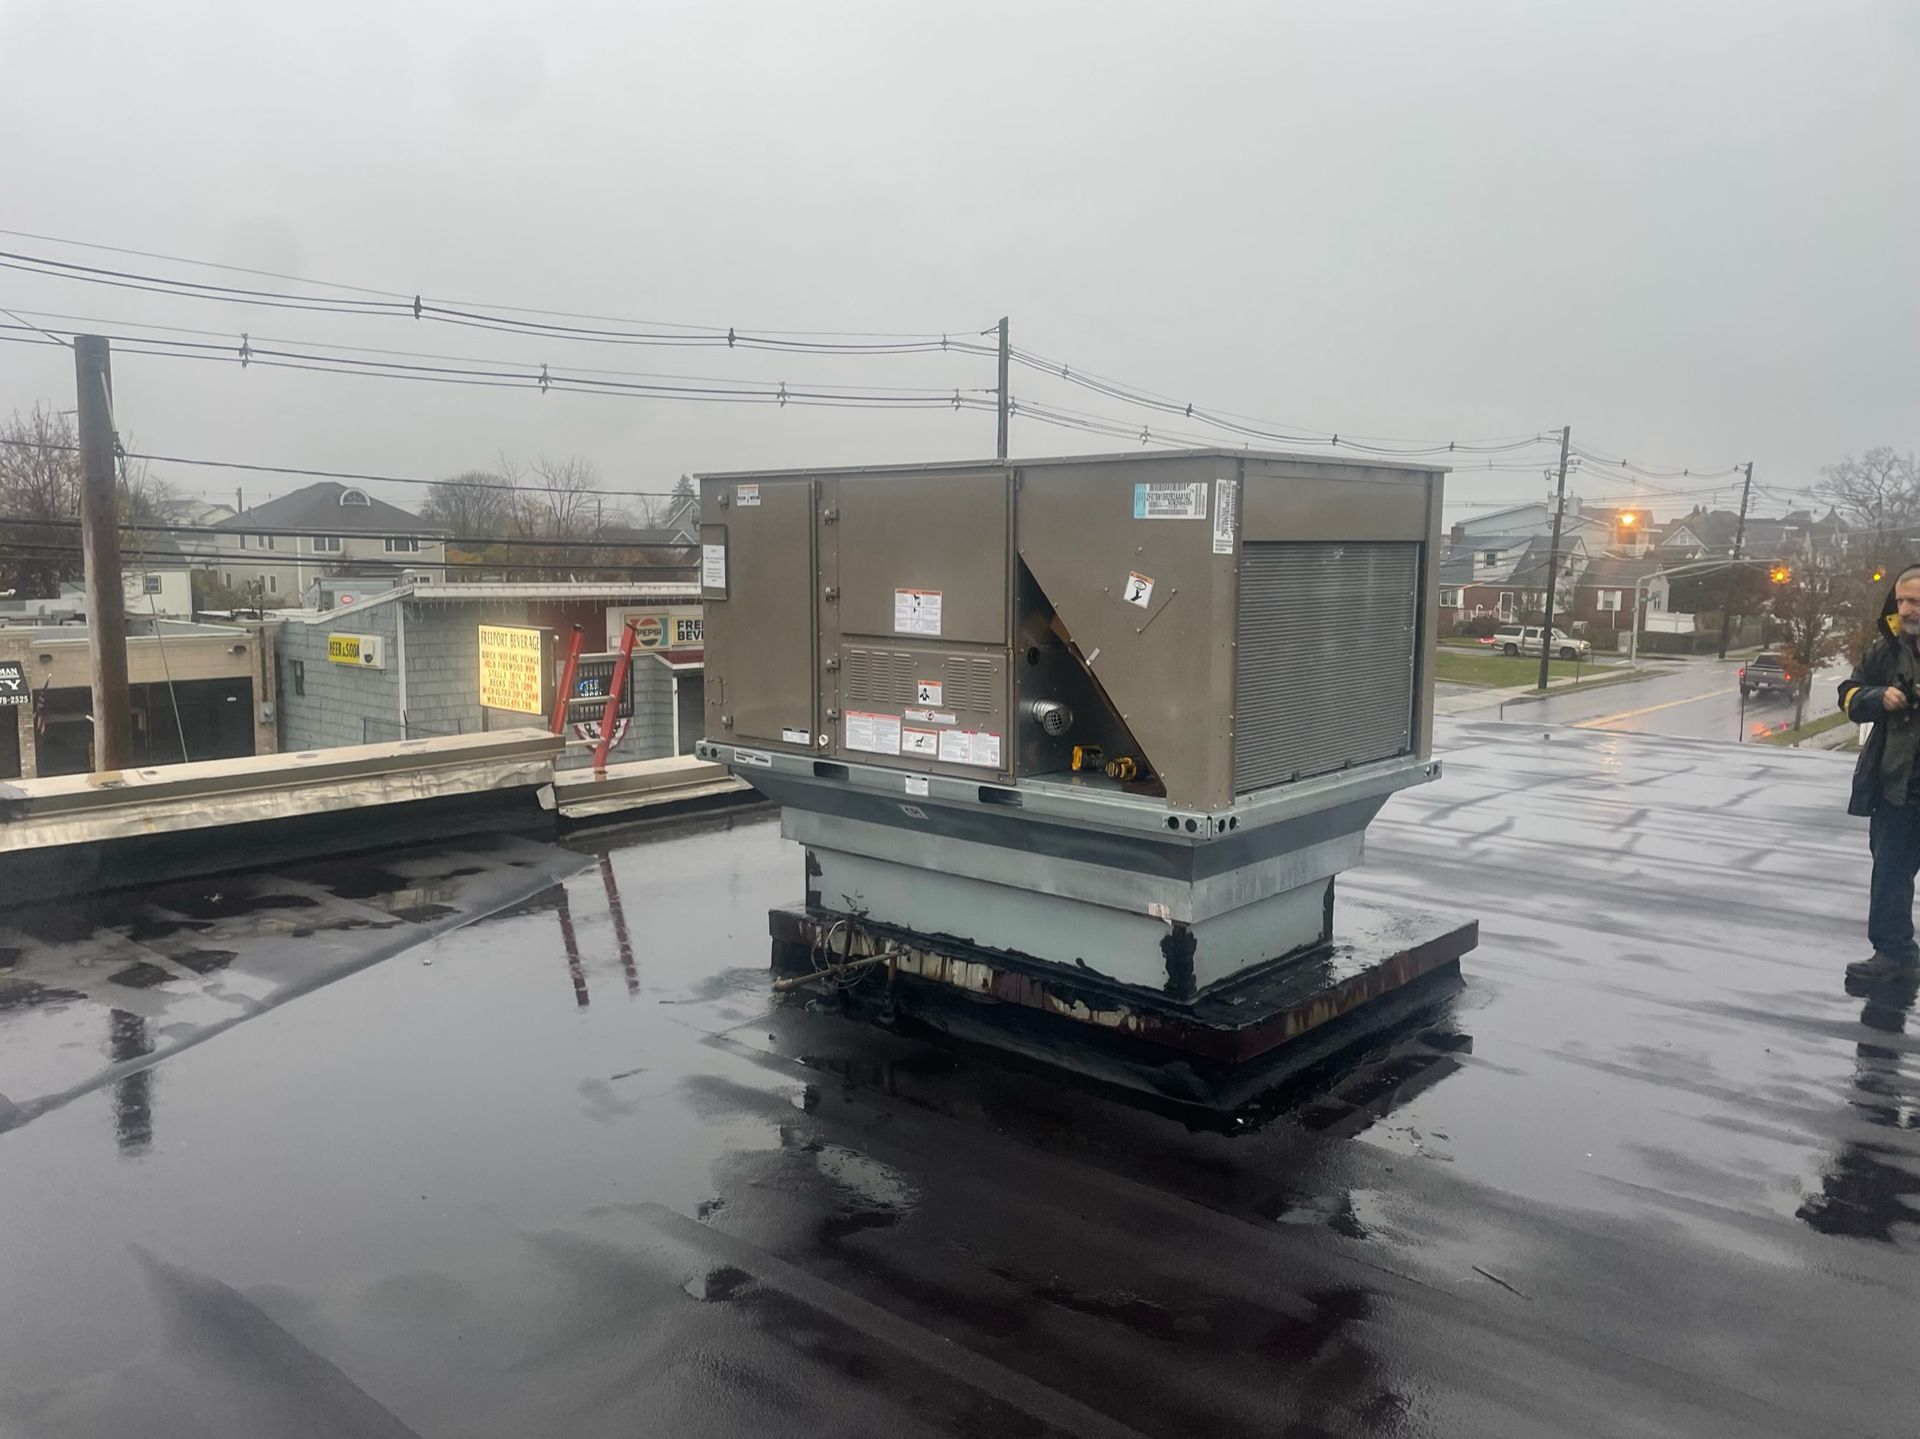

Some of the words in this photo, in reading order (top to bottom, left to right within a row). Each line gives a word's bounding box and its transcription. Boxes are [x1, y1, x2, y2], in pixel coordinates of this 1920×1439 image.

[637, 628, 662, 636] PEPSI
[481, 631, 507, 647] FREEPORT
[510, 634, 539, 650] BEVERAGE
[330, 642, 341, 656] BEER
